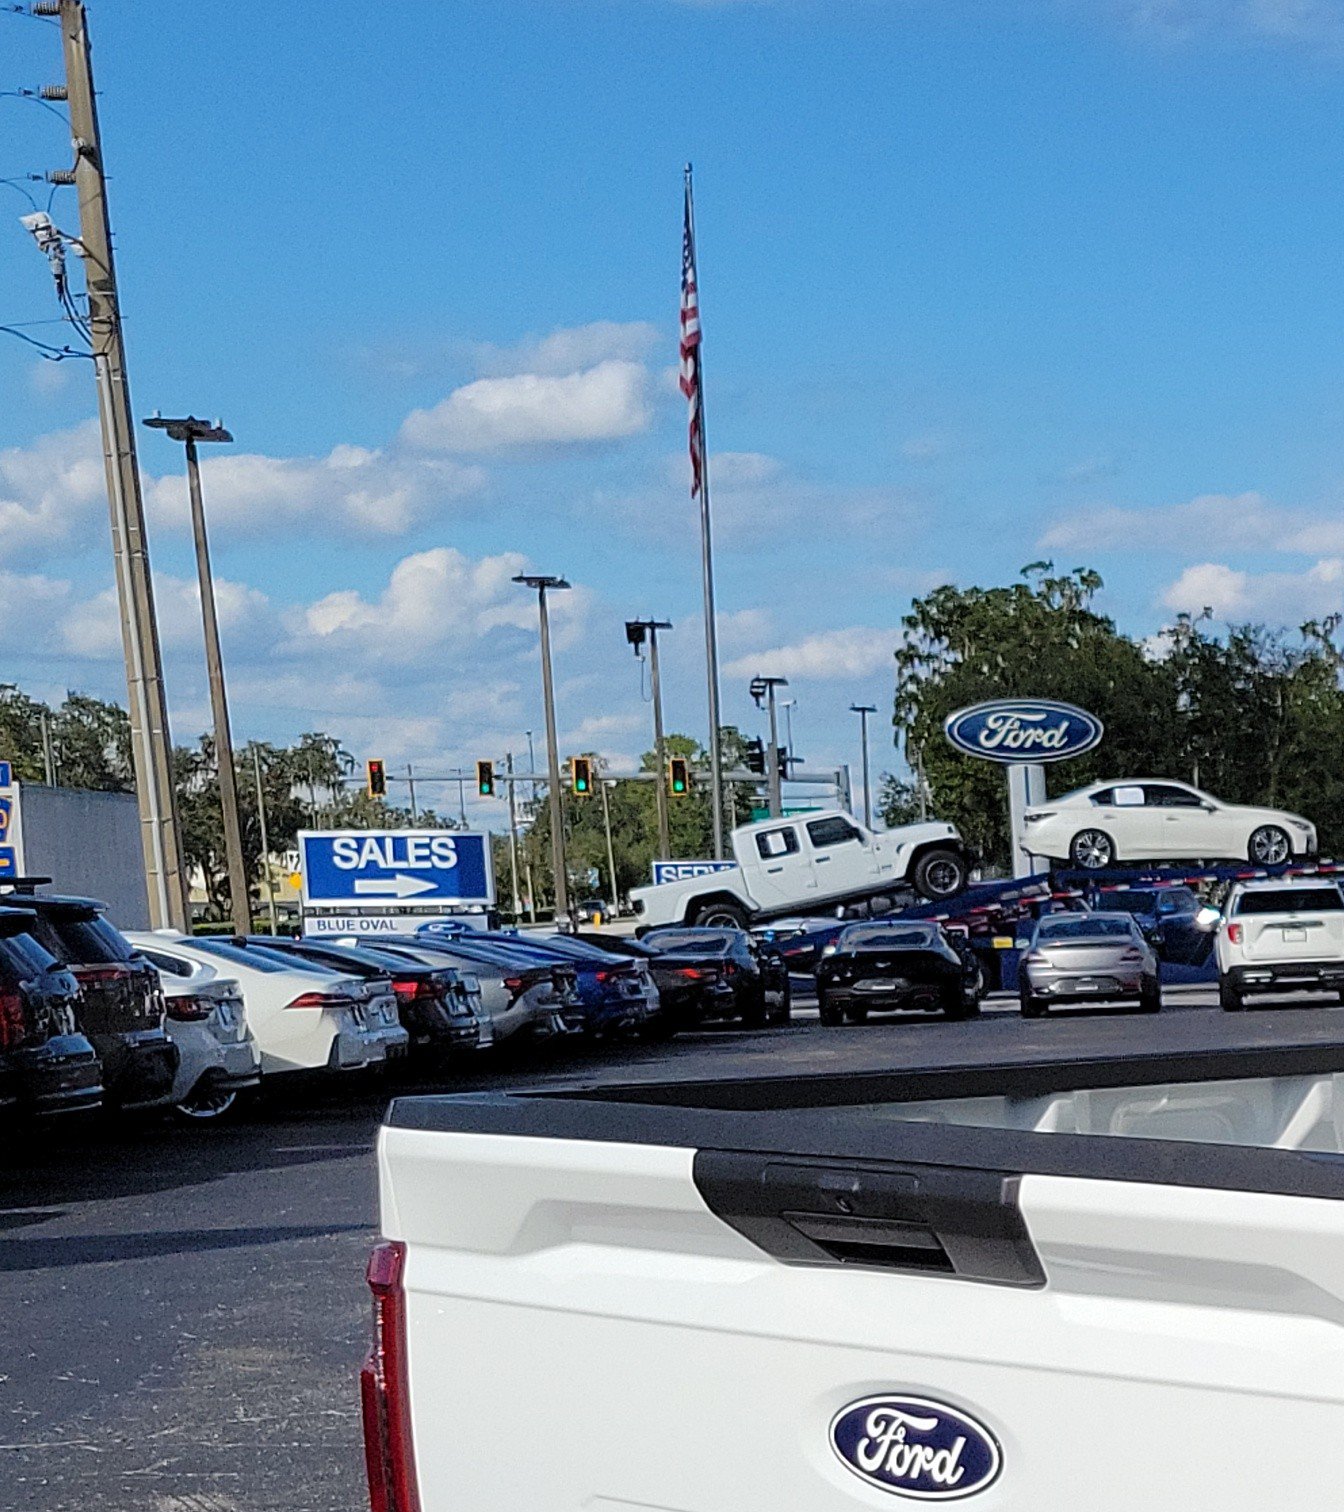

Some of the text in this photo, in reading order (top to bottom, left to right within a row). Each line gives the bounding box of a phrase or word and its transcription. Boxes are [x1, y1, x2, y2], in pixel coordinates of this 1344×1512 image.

[978, 711, 1072, 749] Ford
[332, 837, 458, 870] SALES
[316, 919, 398, 932] BLUE OVAL
[857, 1407, 967, 1485] Ford
